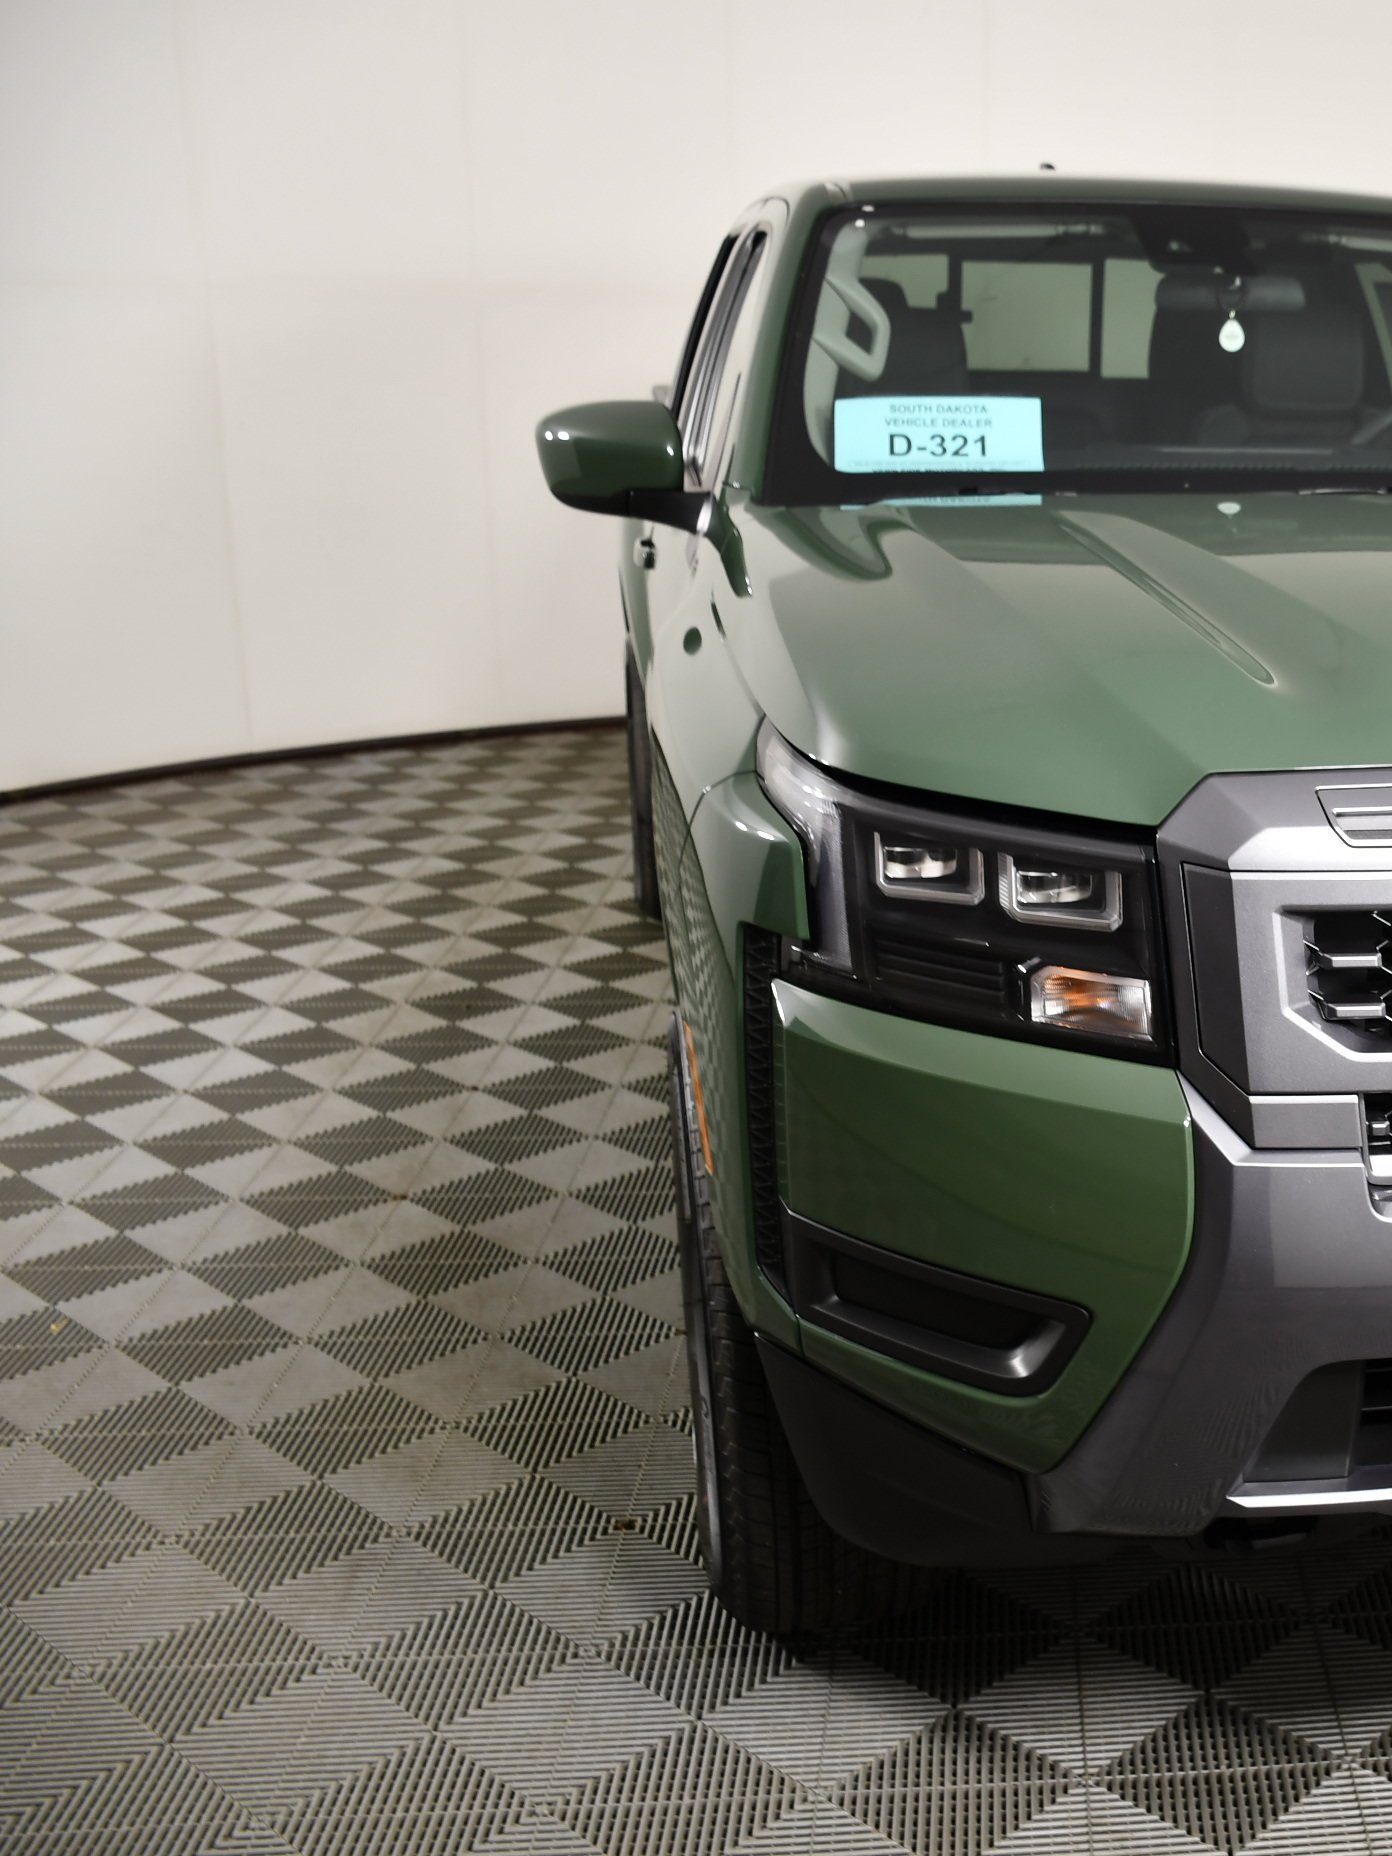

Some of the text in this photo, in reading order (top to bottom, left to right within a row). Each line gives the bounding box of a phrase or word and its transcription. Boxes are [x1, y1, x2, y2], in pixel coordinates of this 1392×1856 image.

[889, 403, 987, 414] SOUTH DAKOTA
[884, 417, 992, 428] VEHICLE DEALER
[889, 433, 987, 457] D-321
